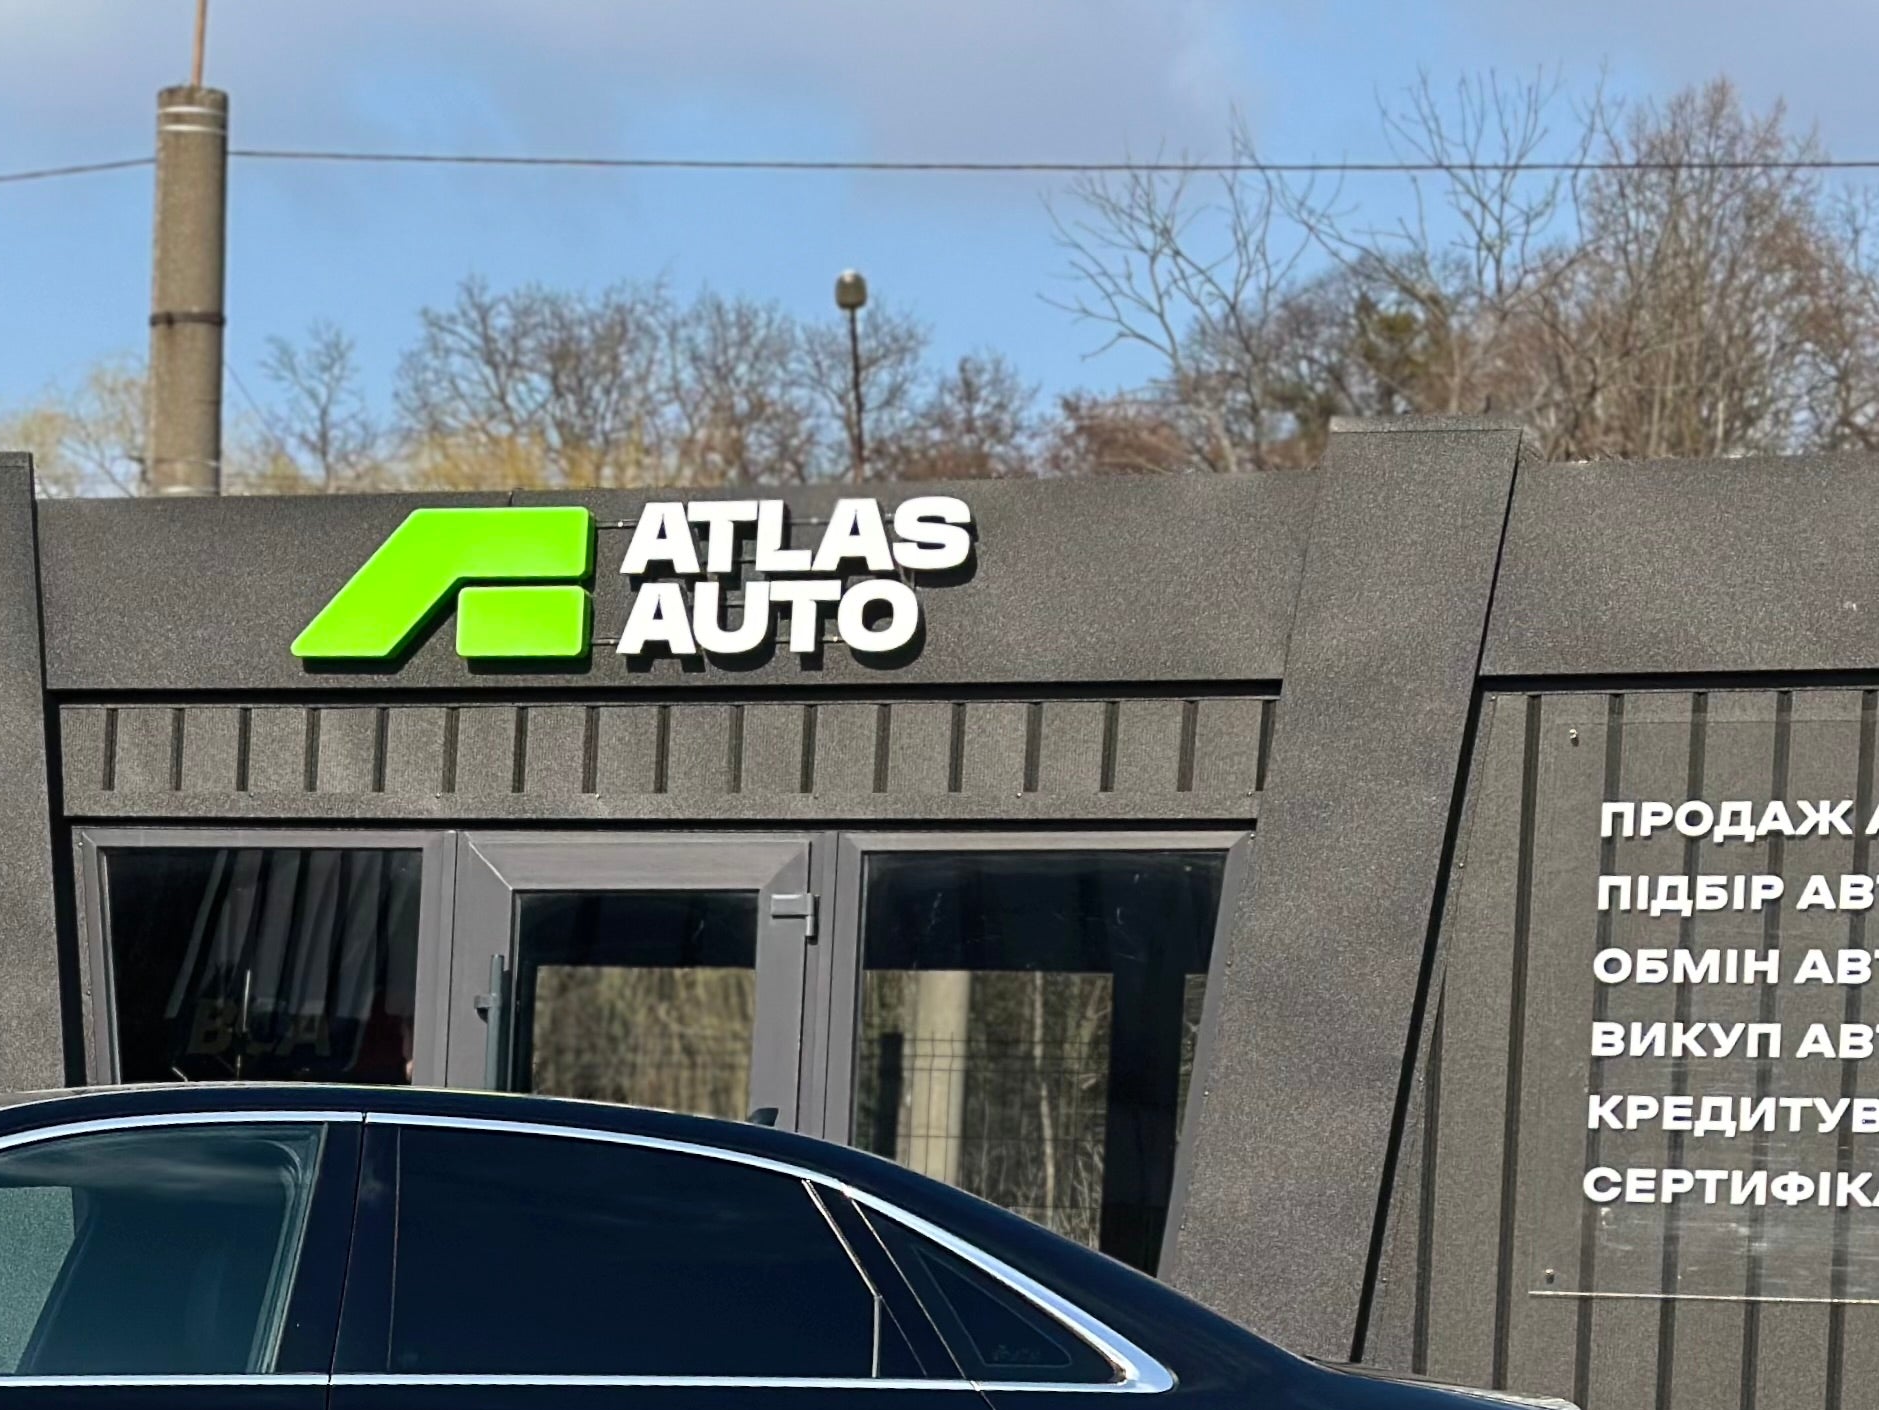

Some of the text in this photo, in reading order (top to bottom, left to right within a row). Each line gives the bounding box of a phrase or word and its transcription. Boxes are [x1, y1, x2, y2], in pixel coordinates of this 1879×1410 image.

[620, 496, 971, 574] ATLAS
[616, 579, 918, 653] AUTO
[1601, 800, 1854, 843] ПРОДАЖ
[1597, 875, 1879, 917] ПІДБІР АВ
[1593, 948, 1879, 984] ОБМІН АВ
[1591, 1021, 1879, 1059] ВИКУП АВ
[1587, 1095, 1879, 1137] КРЕДИТУВ
[1583, 1167, 1879, 1208] СЕРТИФІК
